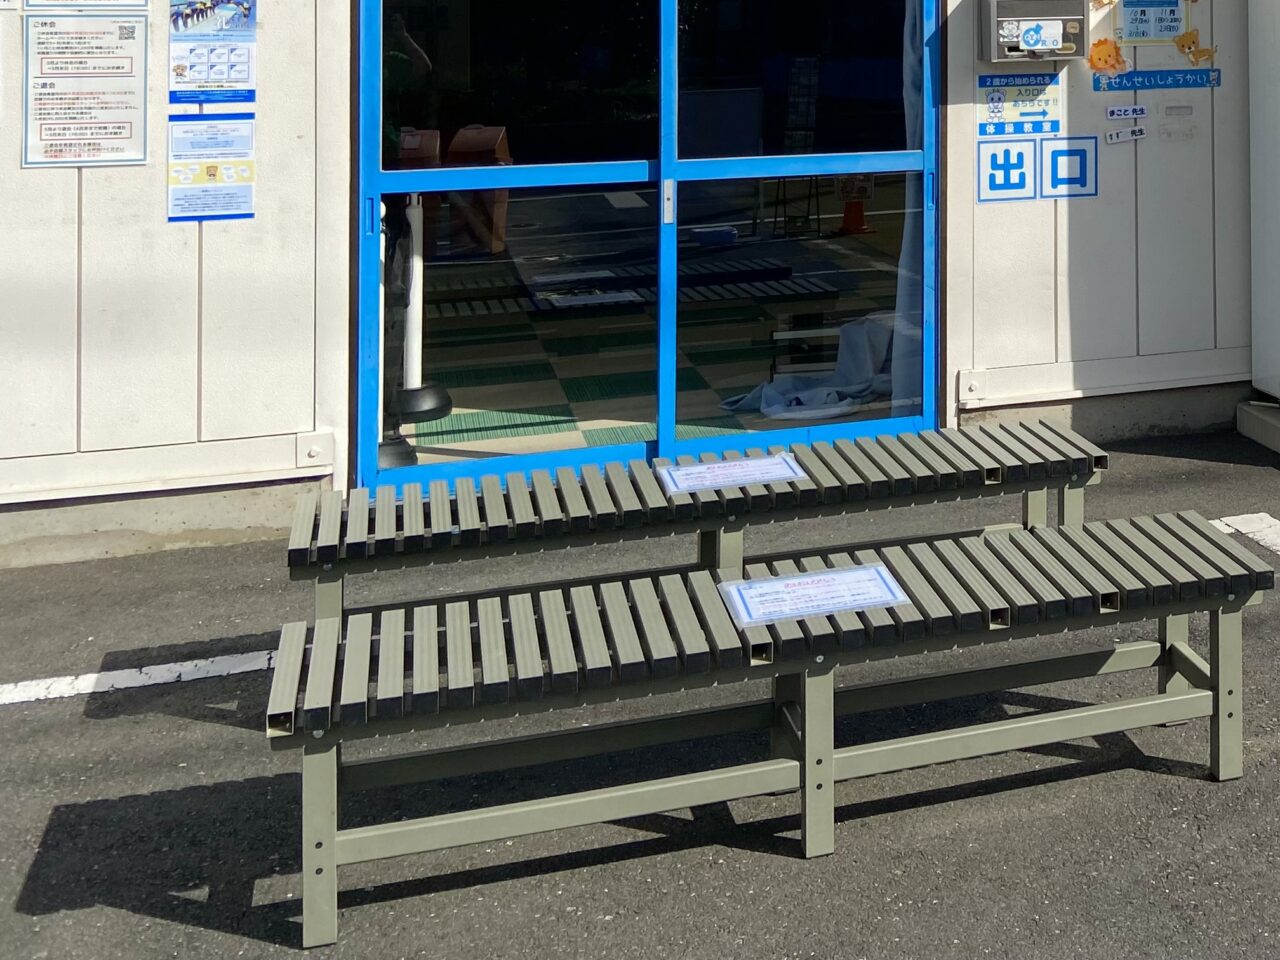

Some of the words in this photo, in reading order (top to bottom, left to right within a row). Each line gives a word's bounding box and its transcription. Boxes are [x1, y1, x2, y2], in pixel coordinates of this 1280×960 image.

[1111, 74, 1207, 87] せんせいしょうかい
[1132, 107, 1146, 115] 先生
[986, 121, 1052, 134] 体操教室
[1131, 128, 1146, 137] 先生
[989, 148, 1087, 190] 出口
